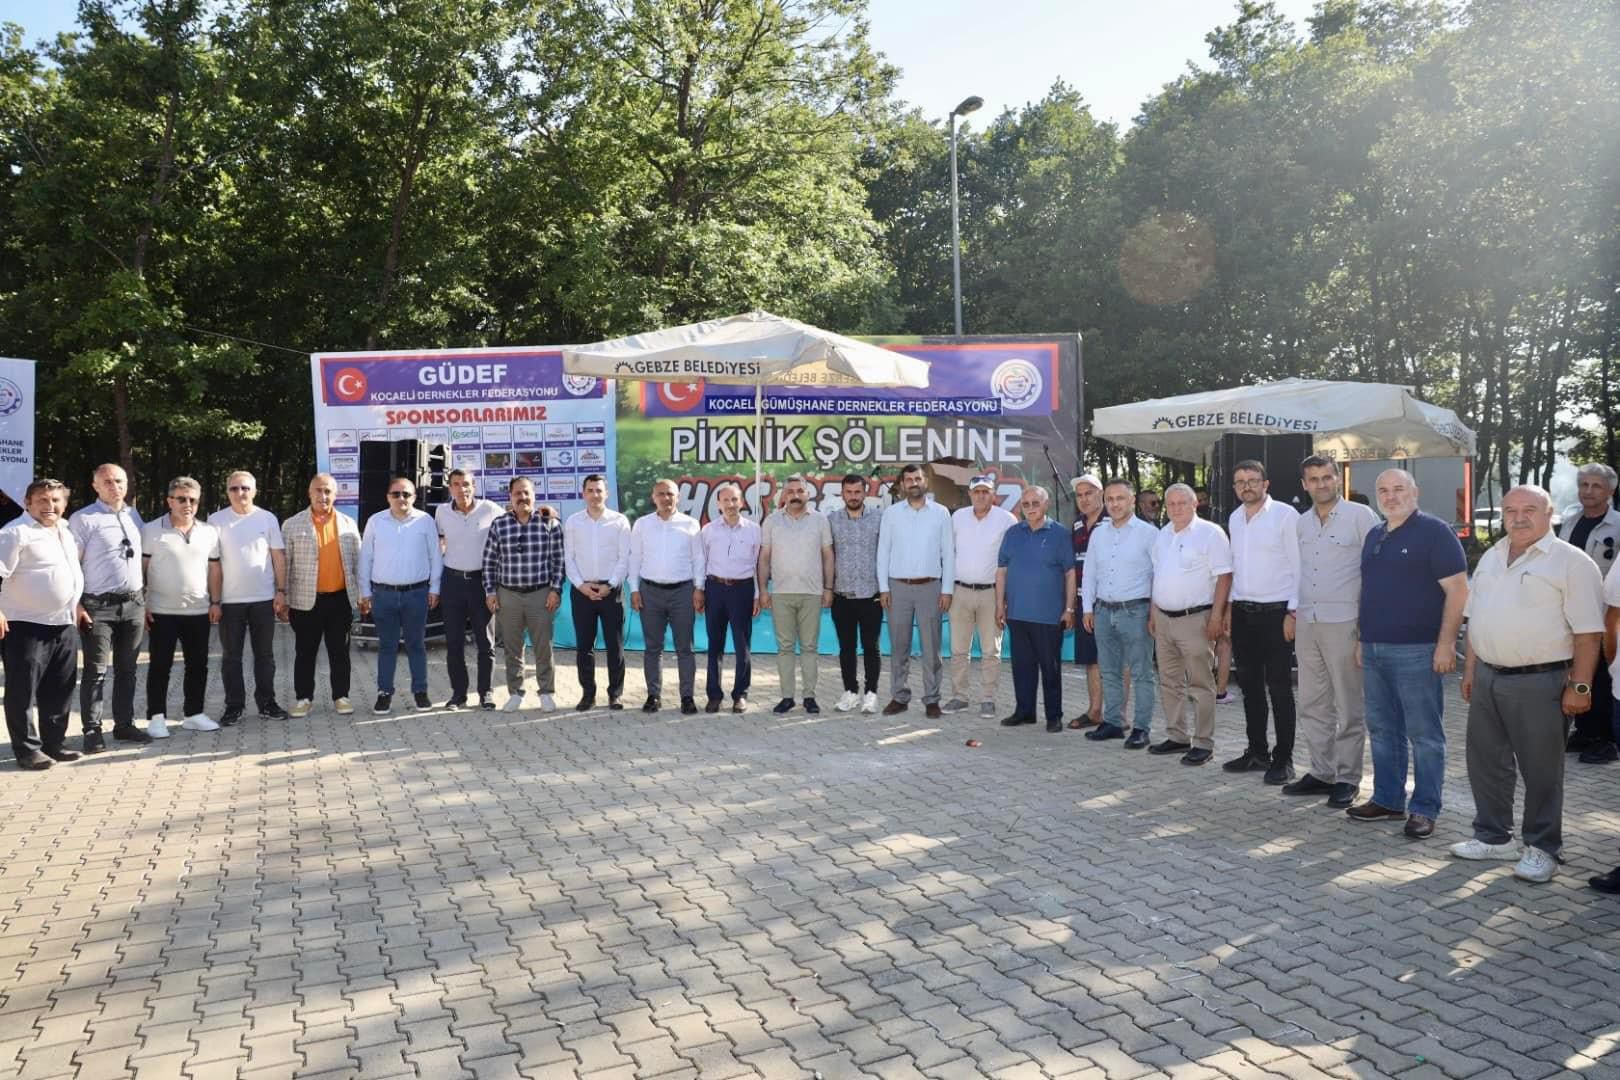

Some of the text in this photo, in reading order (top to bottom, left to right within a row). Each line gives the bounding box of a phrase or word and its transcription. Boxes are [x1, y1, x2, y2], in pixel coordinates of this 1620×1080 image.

[418, 362, 507, 386] GÜDEF
[634, 360, 680, 374] GEBZE
[371, 387, 559, 401] KOCAELİ DERNEKLER FEDERASYONU
[709, 397, 997, 413] KOCAEL GÜMÜŞHANE DERNEKLER FEDERASYONU
[1175, 412, 1225, 428] GEBZE
[0, 439, 25, 447] HANE
[672, 418, 1023, 470] PİKNİK ŞÖLENİNE
[0, 455, 28, 464] SYONU
